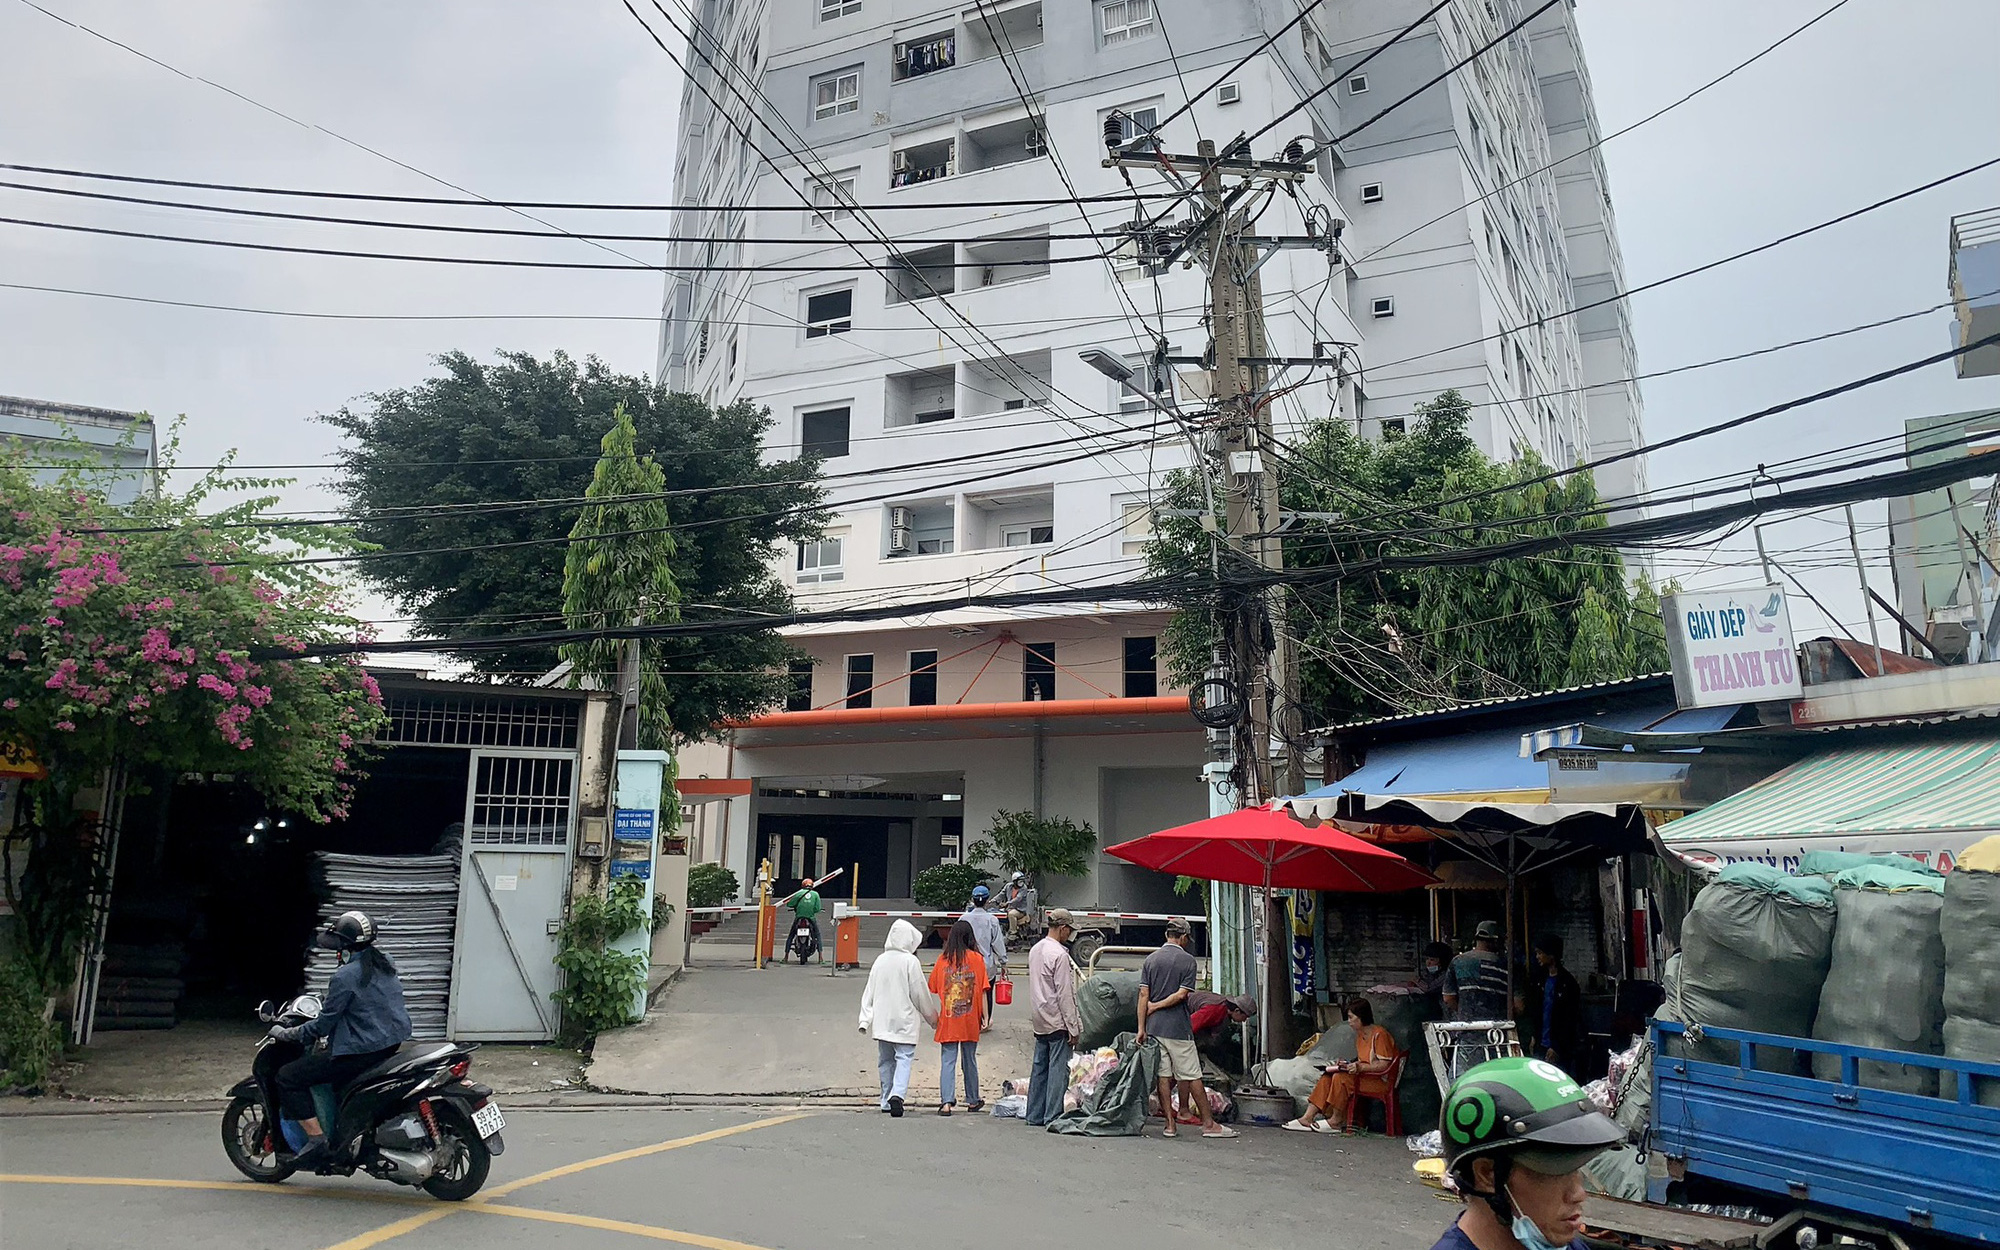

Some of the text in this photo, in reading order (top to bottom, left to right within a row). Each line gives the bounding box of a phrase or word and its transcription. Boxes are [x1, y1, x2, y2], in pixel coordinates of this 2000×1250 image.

[1687, 600, 1746, 640] GIÀY DÉP
[1693, 637, 1794, 692] THANH TÚ
[1798, 707, 1817, 719] 225
[630, 818, 652, 828] THÀNH
